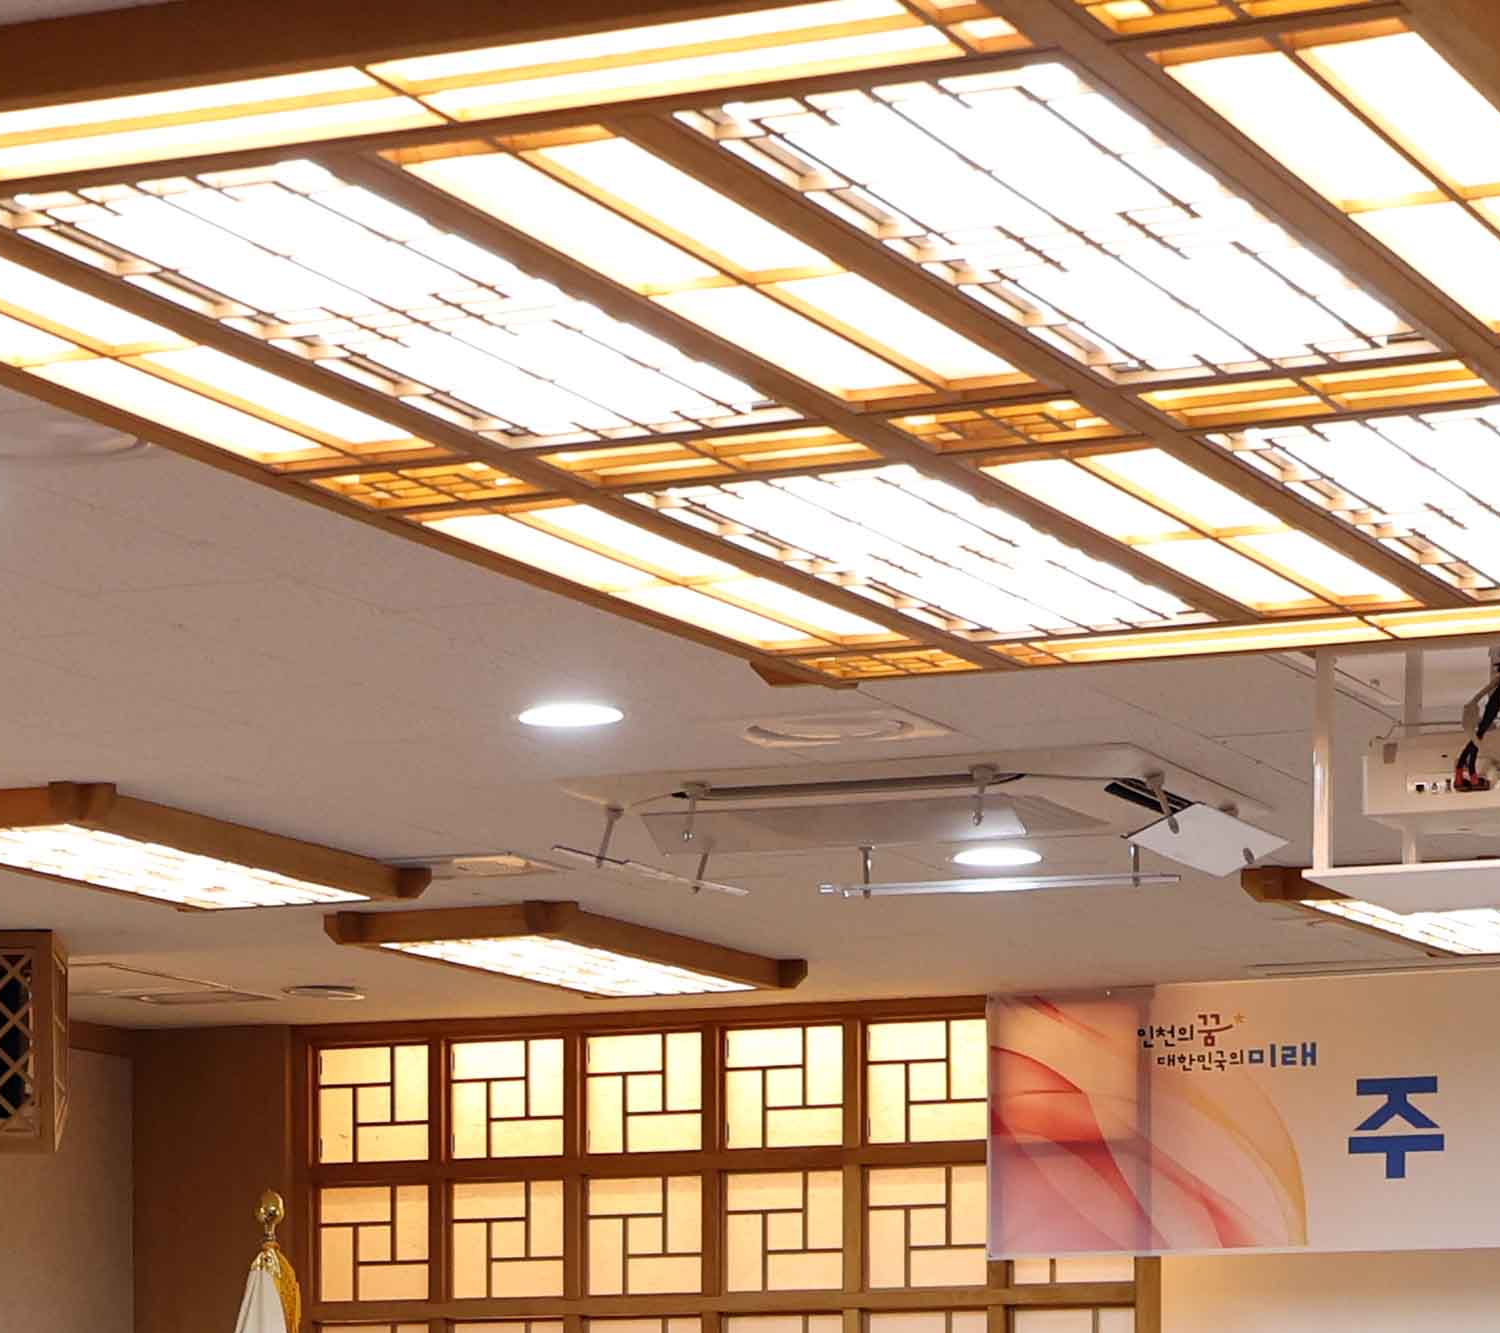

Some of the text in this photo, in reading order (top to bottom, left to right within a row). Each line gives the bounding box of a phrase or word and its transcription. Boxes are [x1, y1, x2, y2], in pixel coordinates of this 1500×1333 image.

[1137, 1013, 1234, 1049] 인천의 꿈
[1157, 1041, 1317, 1071] 대한민국의 미래
